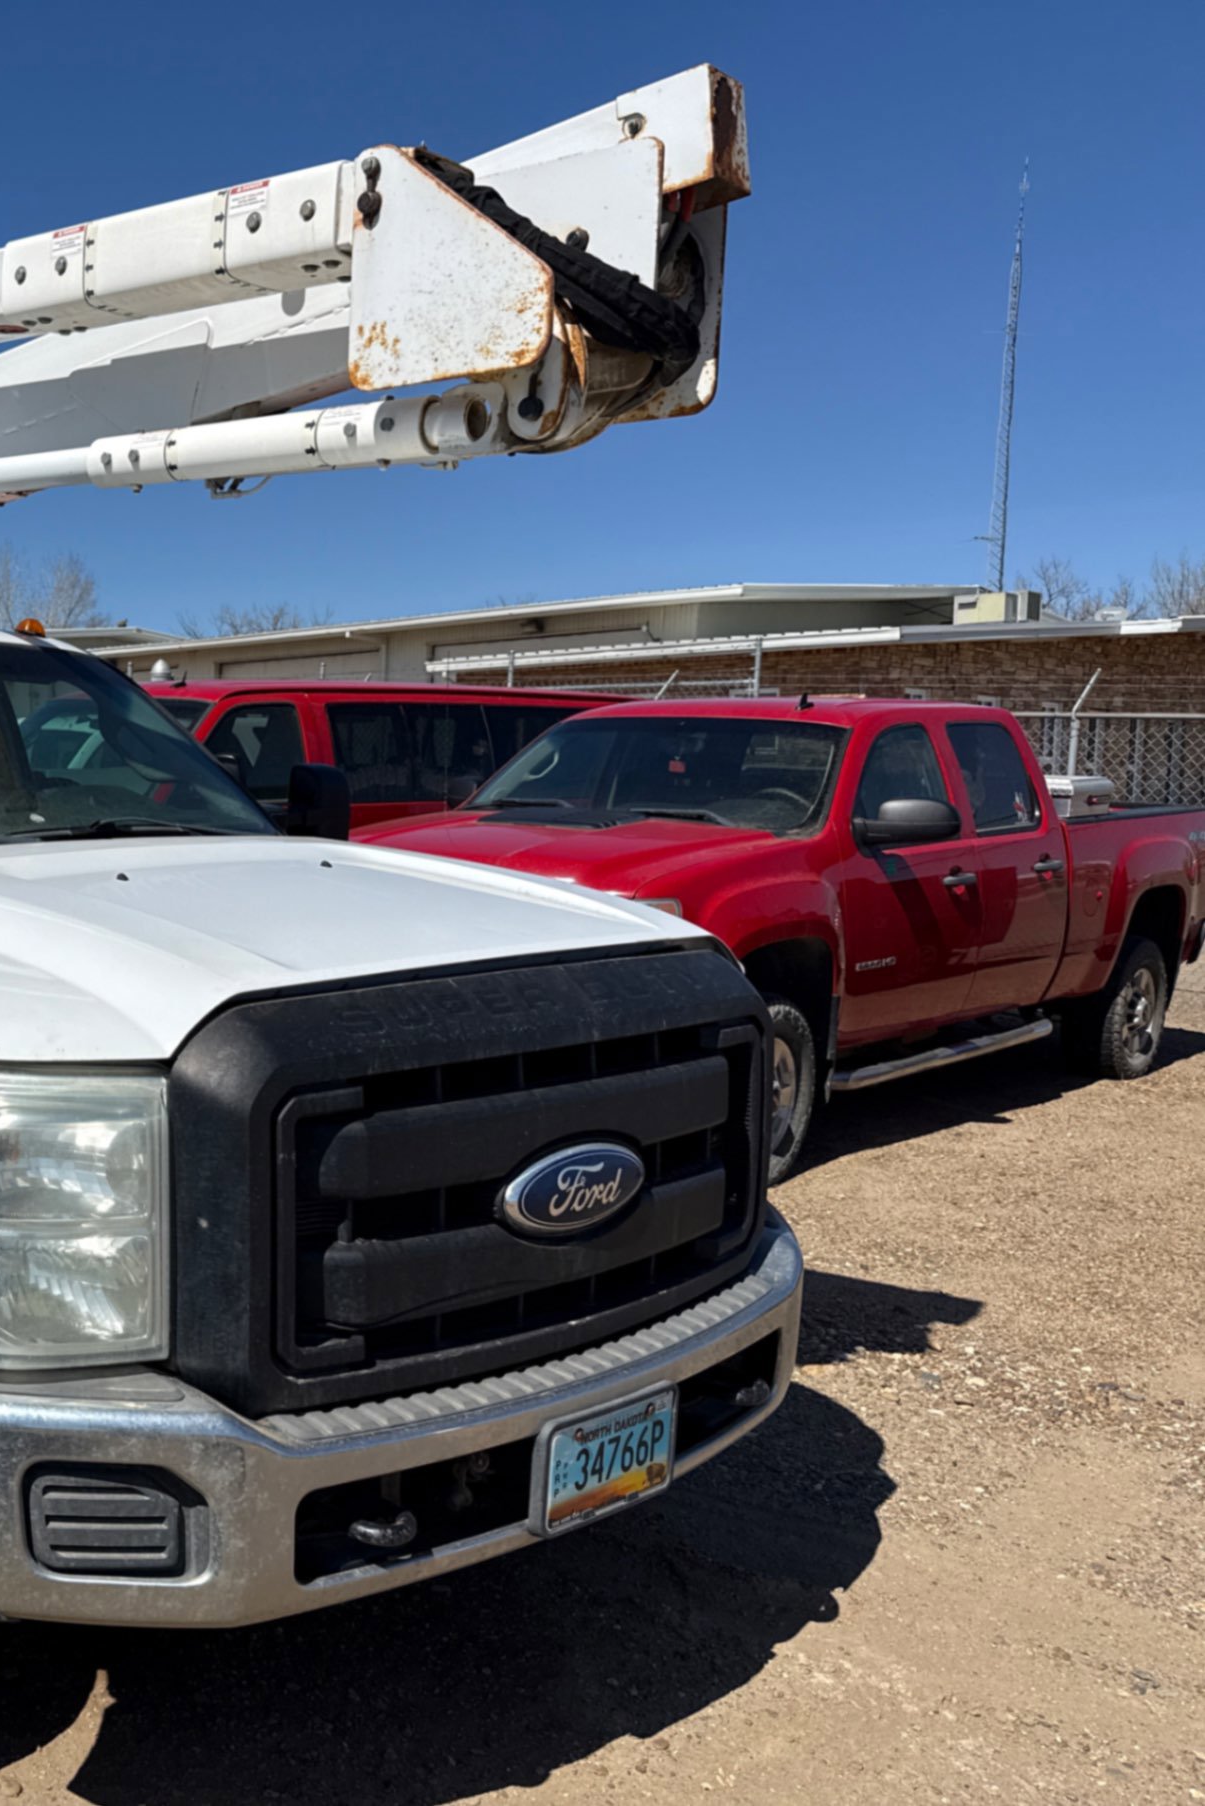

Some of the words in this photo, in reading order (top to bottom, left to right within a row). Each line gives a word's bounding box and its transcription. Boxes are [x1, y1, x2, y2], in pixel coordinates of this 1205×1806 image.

[331, 976, 557, 1038] SUPER
[549, 1161, 622, 1217] Ford
[574, 1419, 664, 1491] 34766P
